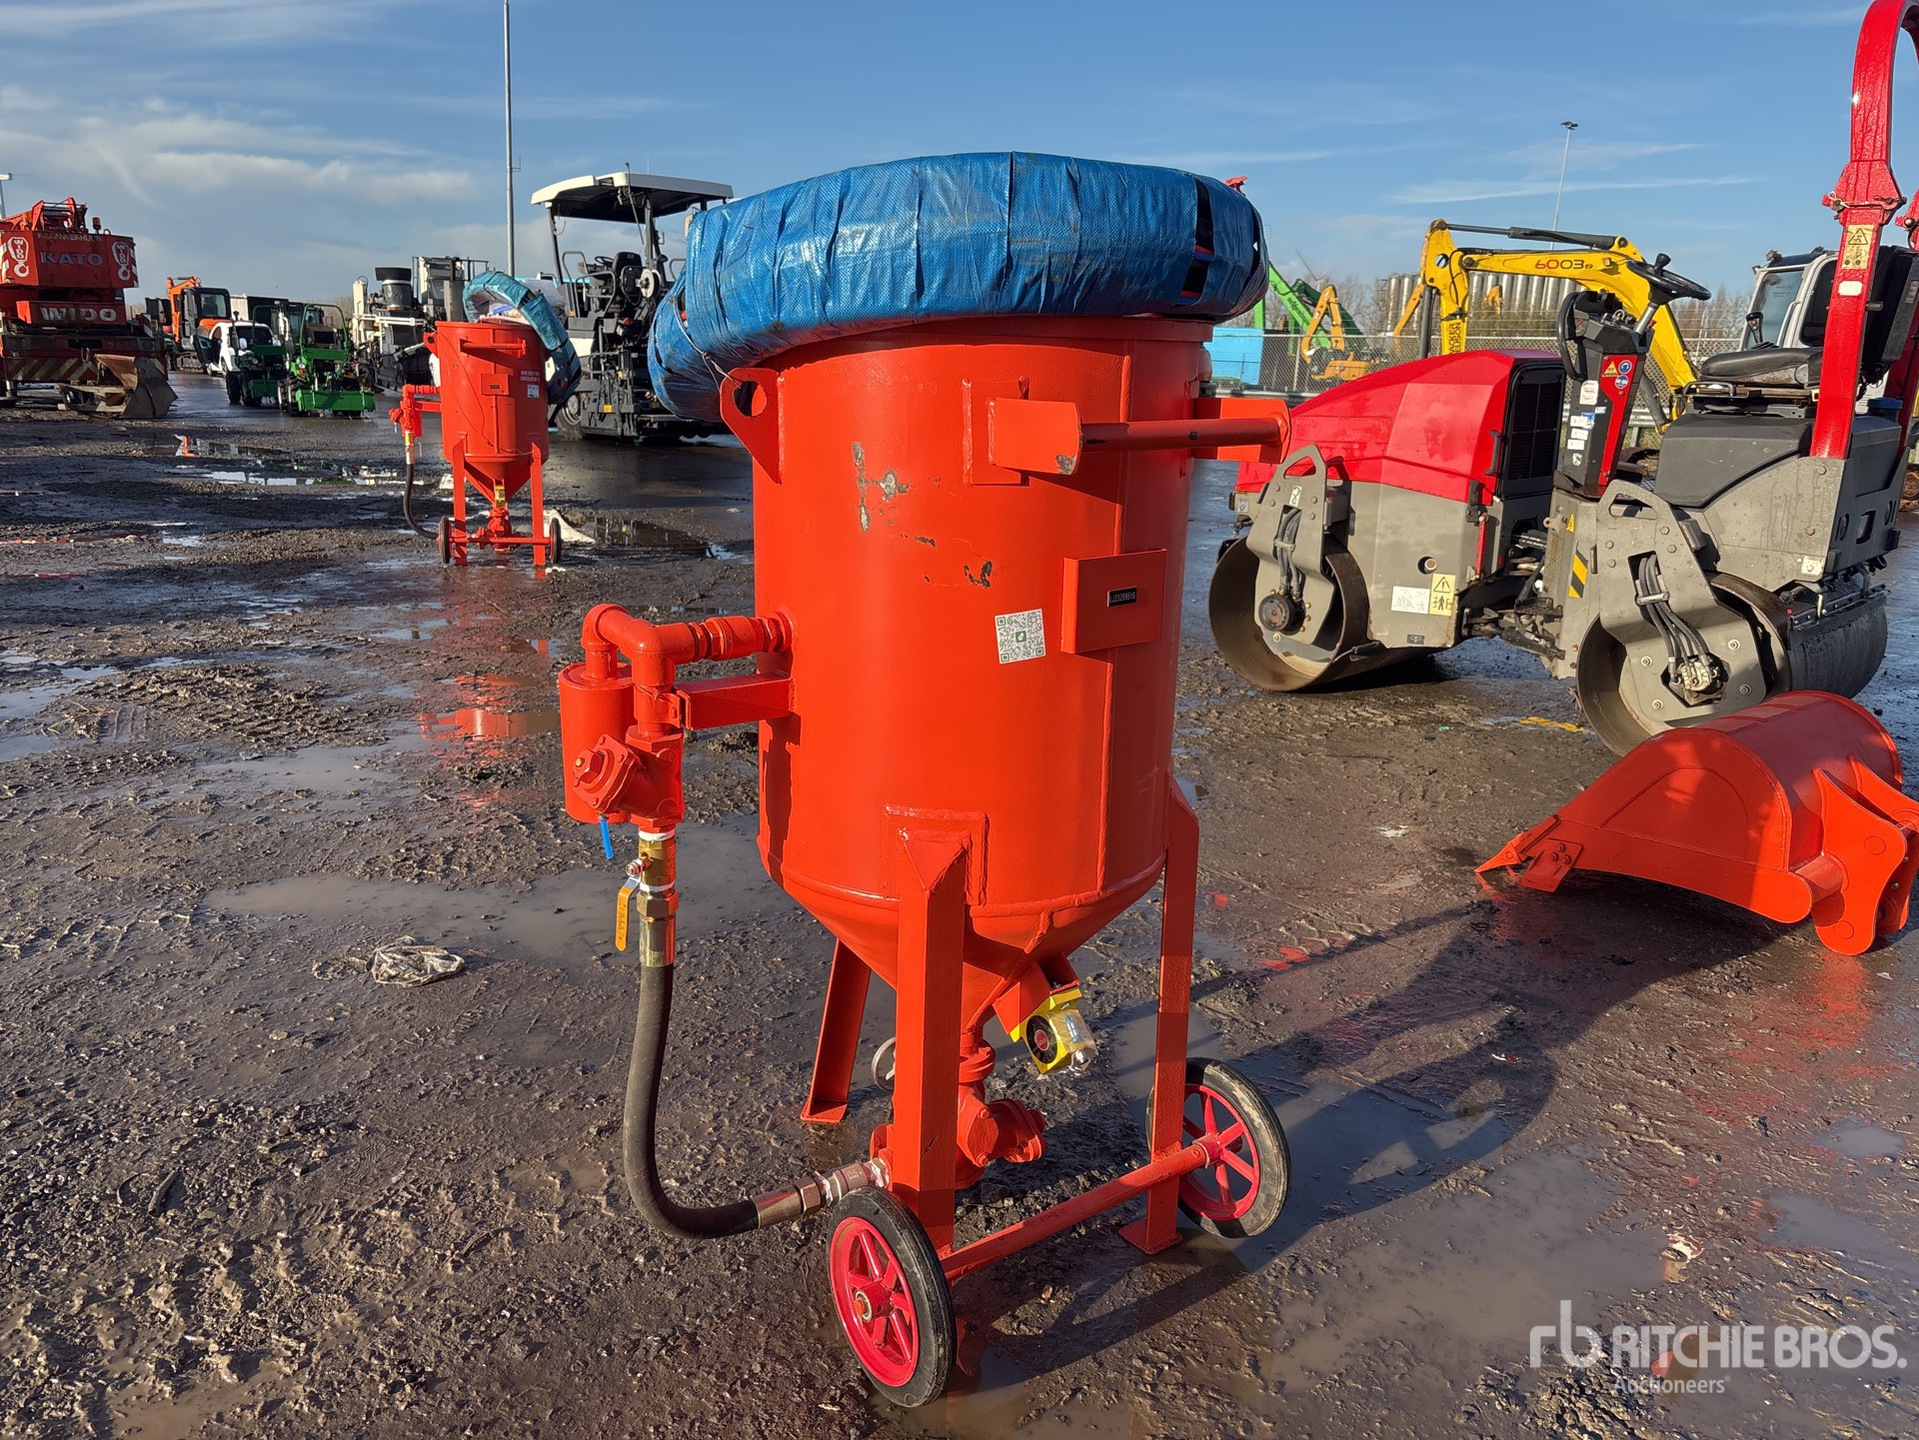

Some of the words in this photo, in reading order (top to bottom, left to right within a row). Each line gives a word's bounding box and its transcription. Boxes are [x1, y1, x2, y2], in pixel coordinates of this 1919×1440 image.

[40, 252, 104, 266] KATO
[1535, 260, 1585, 270] 6003
[40, 307, 117, 322] WIDO
[1454, 322, 1462, 353] EUSON
